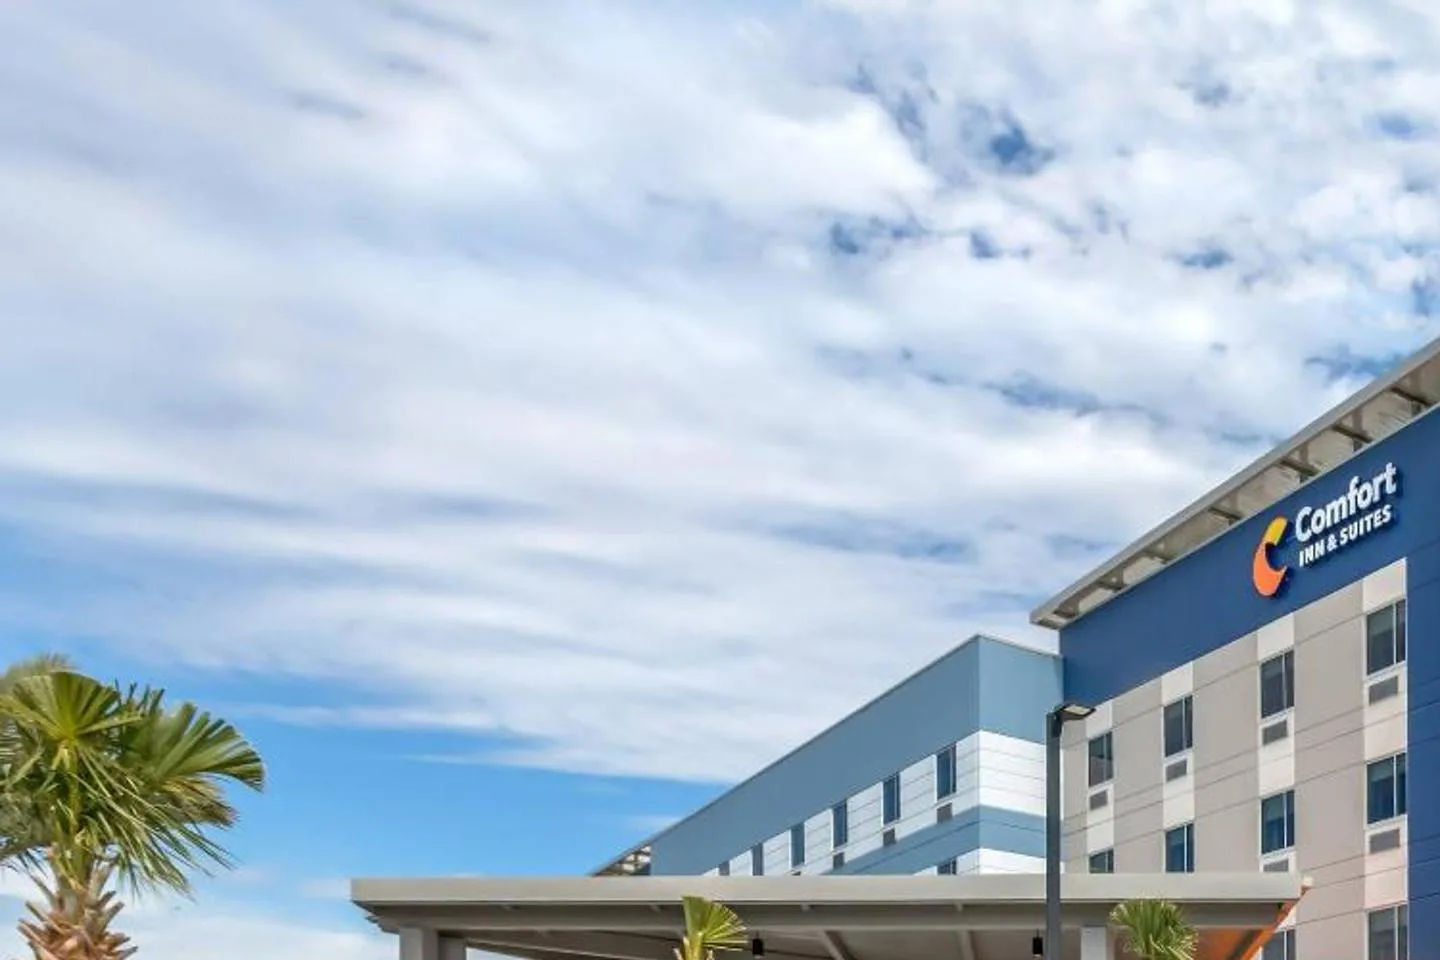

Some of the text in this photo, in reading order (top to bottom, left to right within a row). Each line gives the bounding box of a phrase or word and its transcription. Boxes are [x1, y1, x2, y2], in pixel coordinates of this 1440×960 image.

[1295, 462, 1397, 542] Comfort
[1299, 504, 1392, 567] INN & SUITES
